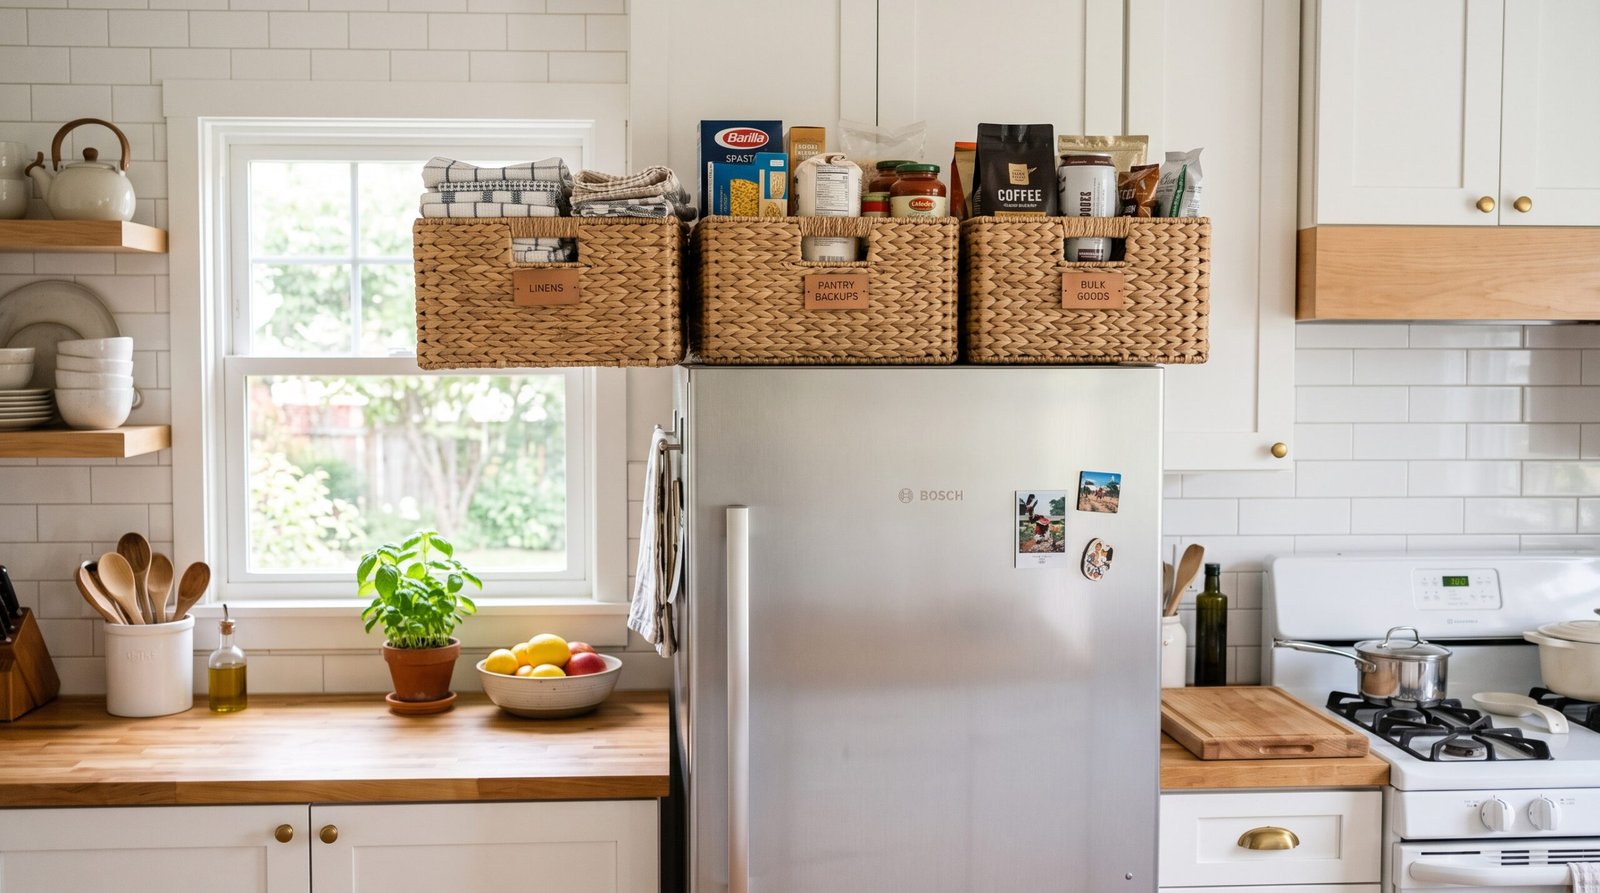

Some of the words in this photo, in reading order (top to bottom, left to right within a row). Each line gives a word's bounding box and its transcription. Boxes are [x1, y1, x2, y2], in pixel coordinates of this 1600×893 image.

[727, 132, 765, 143] Barilla
[726, 154, 756, 163] SPAST
[998, 189, 1042, 201] COFFEE
[529, 284, 564, 292] LINENS
[818, 281, 855, 289] PANTRY
[1081, 281, 1106, 289] BULK
[815, 292, 859, 301] BACKUPS
[1077, 292, 1110, 300] GOODS
[920, 490, 963, 501] BOSCH
